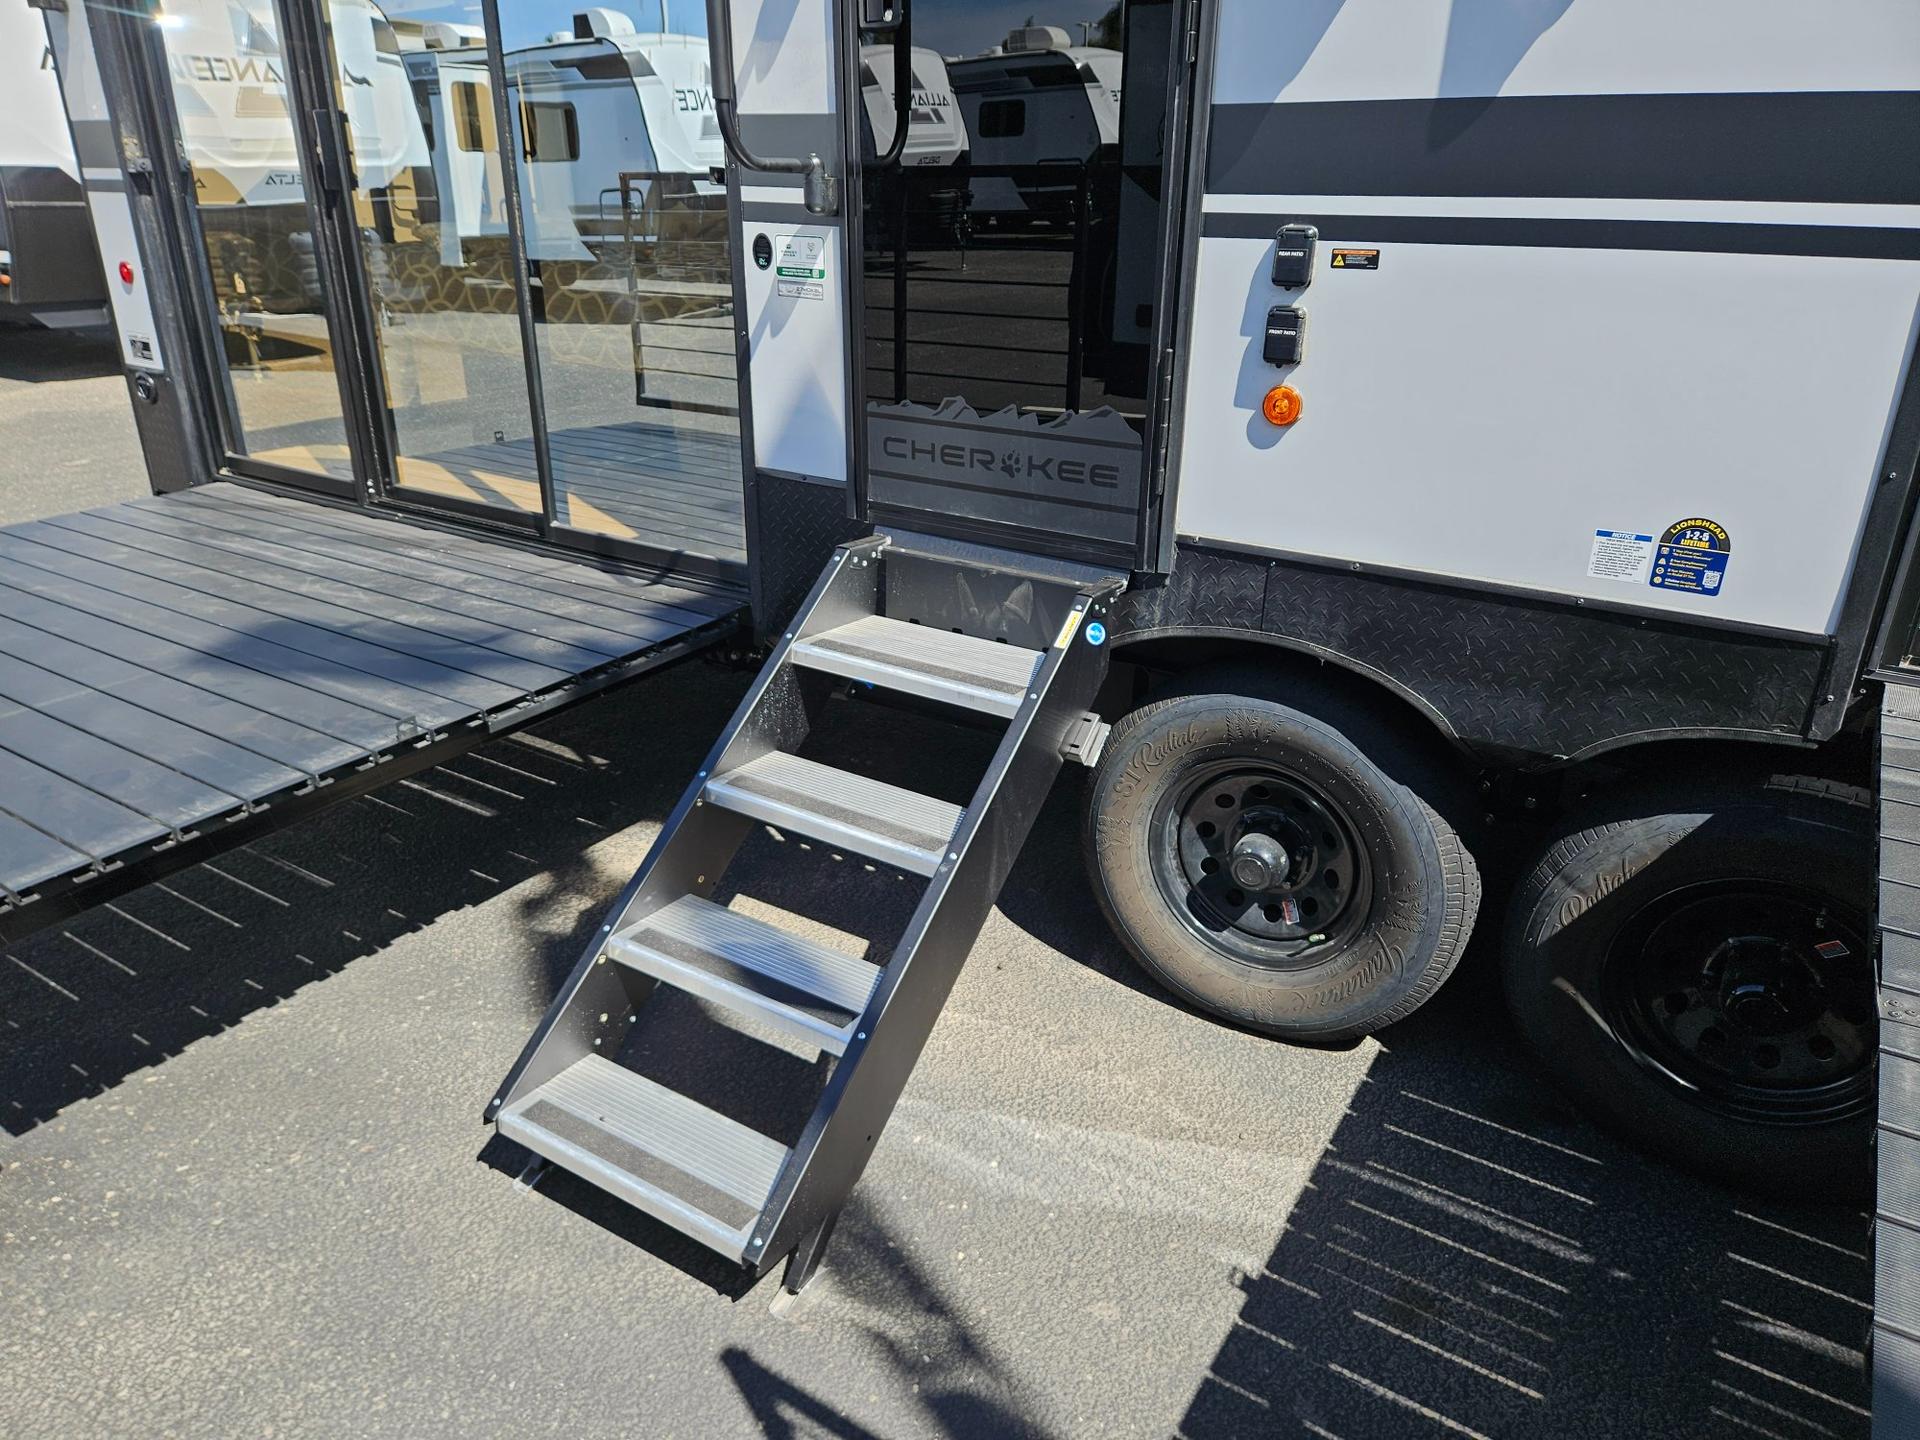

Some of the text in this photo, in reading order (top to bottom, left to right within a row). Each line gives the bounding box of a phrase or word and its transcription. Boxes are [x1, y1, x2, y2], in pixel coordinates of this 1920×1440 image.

[1670, 519, 1726, 541] LIONSHEAD
[1611, 532, 1636, 541] NOTICE
[1680, 539, 1710, 549] LIFETIME
